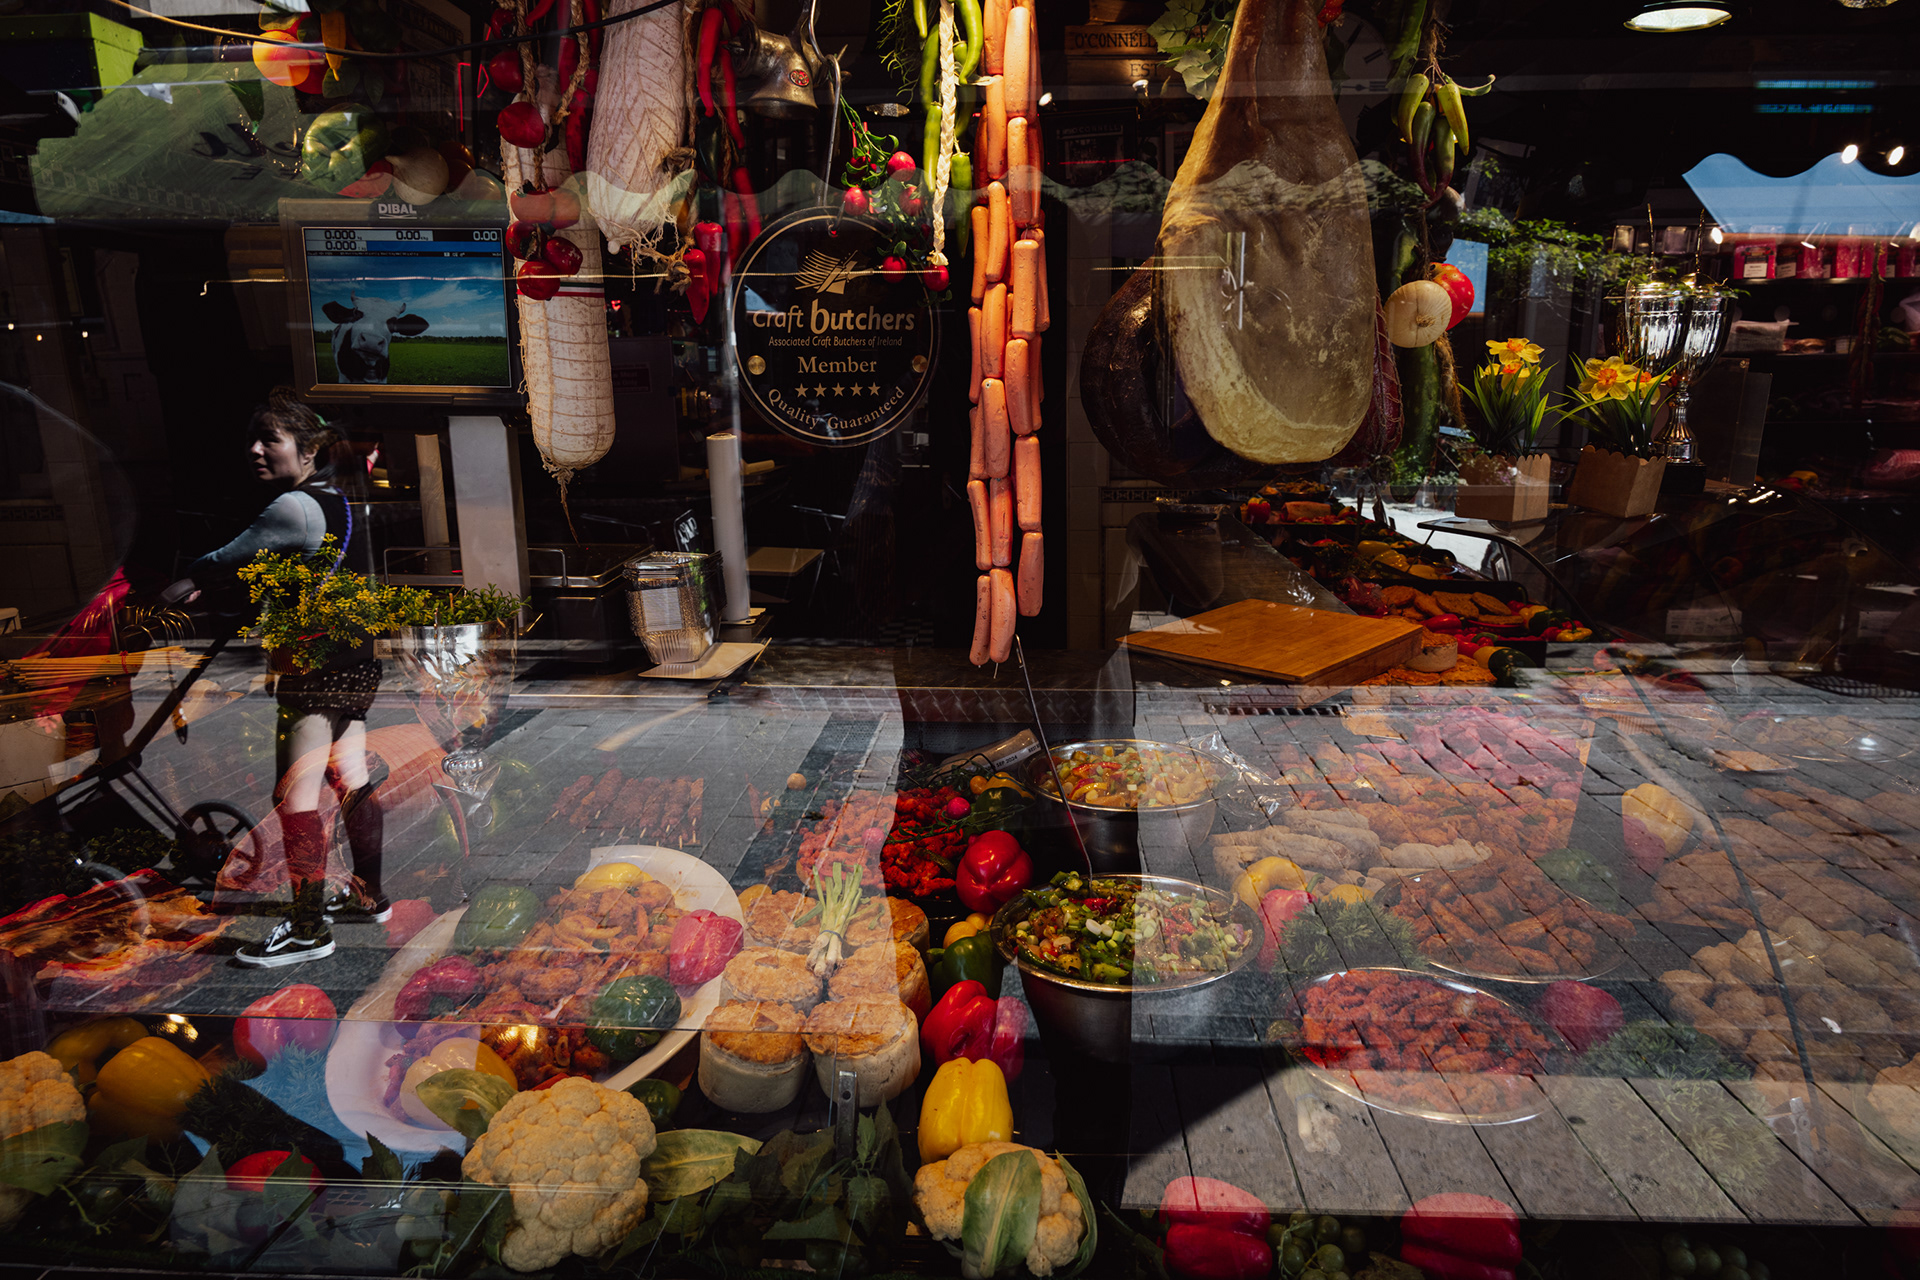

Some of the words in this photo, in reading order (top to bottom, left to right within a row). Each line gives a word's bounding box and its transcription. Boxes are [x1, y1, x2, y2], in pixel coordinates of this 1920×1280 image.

[377, 203, 417, 214] DIBAL
[324, 230, 356, 240] 0.000
[396, 230, 420, 240] 0.00
[472, 230, 498, 241] 0.00
[325, 241, 357, 250] 0.000
[810, 298, 915, 334] butchers
[768, 336, 810, 347] Associated
[812, 335, 831, 348] Craft
[833, 336, 866, 347] Butchers
[867, 335, 876, 348] of
[877, 336, 903, 347] Ireland
[797, 356, 877, 374] Member
[768, 388, 820, 430] Quality
[827, 386, 906, 430] Guaranteed
[1006, 755, 1018, 763] 2024
